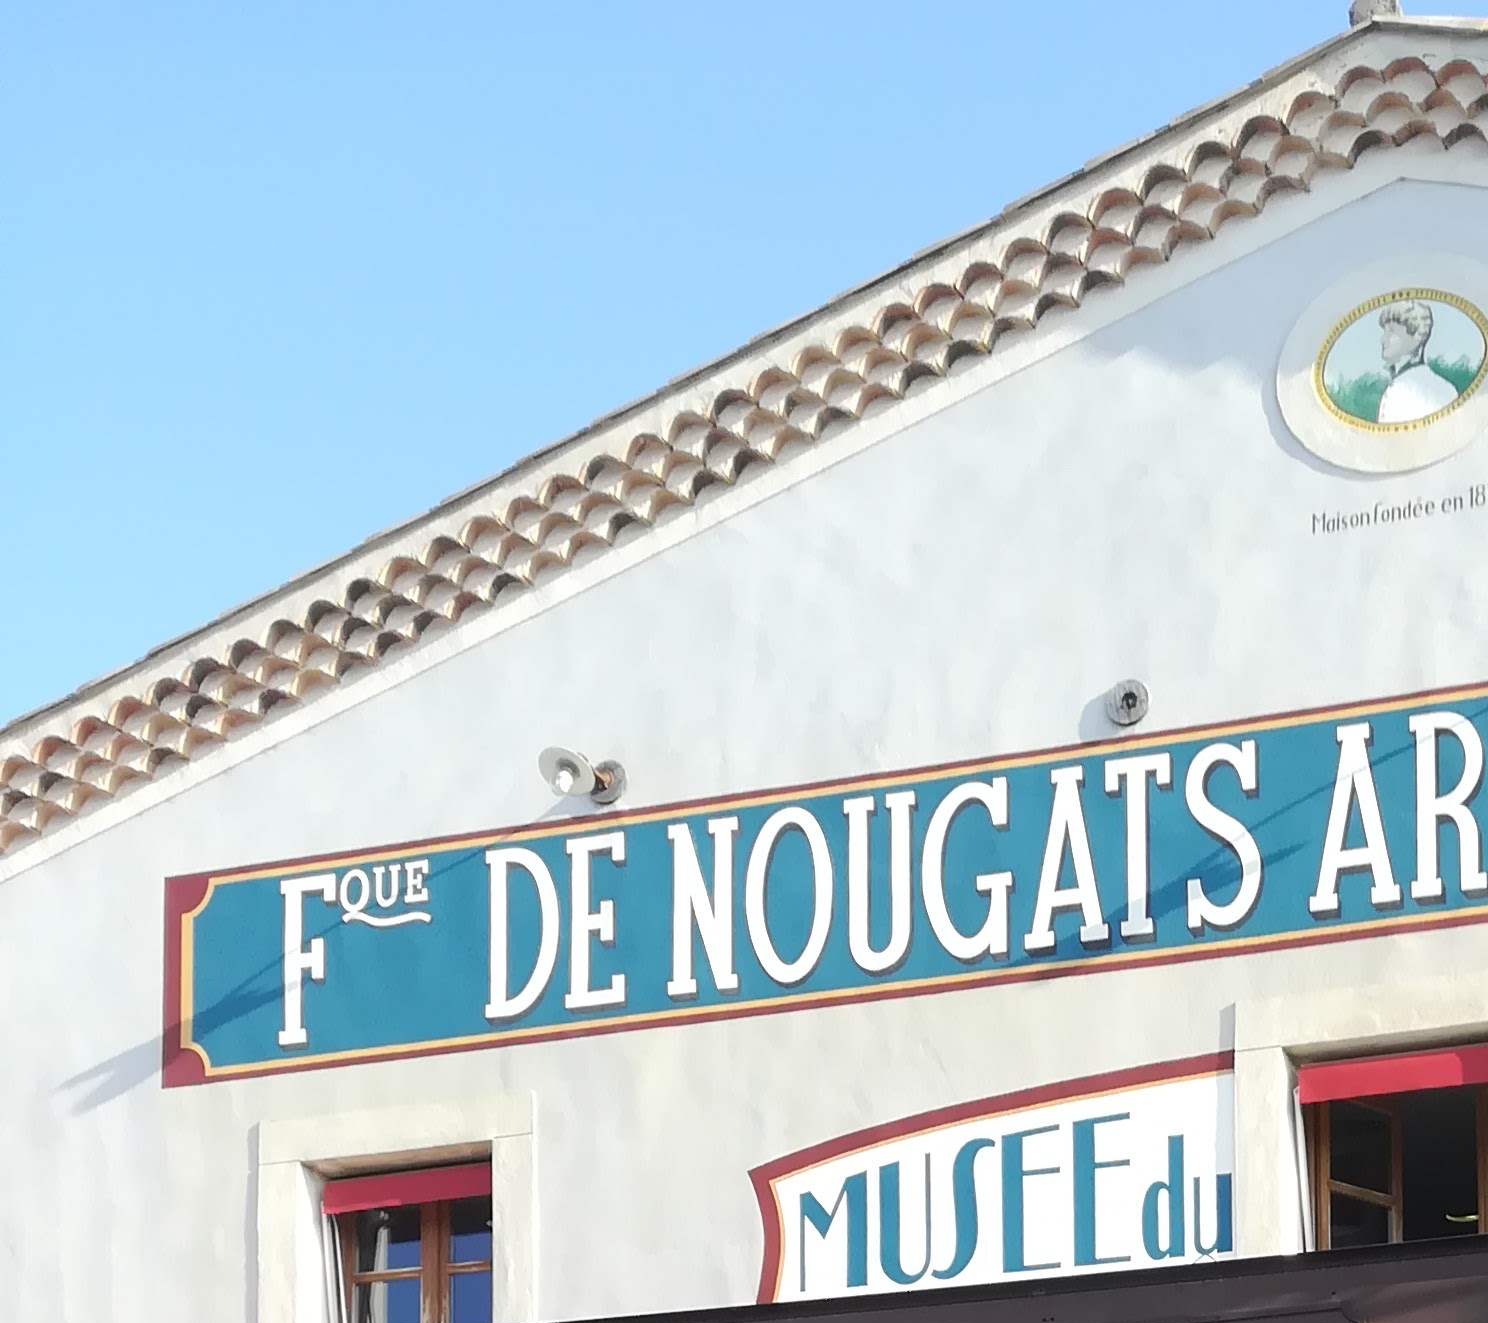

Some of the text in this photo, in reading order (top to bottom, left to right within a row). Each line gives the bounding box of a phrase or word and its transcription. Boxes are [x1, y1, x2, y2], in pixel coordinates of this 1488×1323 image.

[1311, 511, 1370, 535] Maison
[1374, 496, 1435, 525] fondée
[1441, 494, 1464, 513] en
[484, 830, 626, 1020] DE
[667, 739, 1262, 997] NOUGATS
[800, 1111, 1131, 1292] MUSEE
[1141, 1134, 1232, 1263] du
